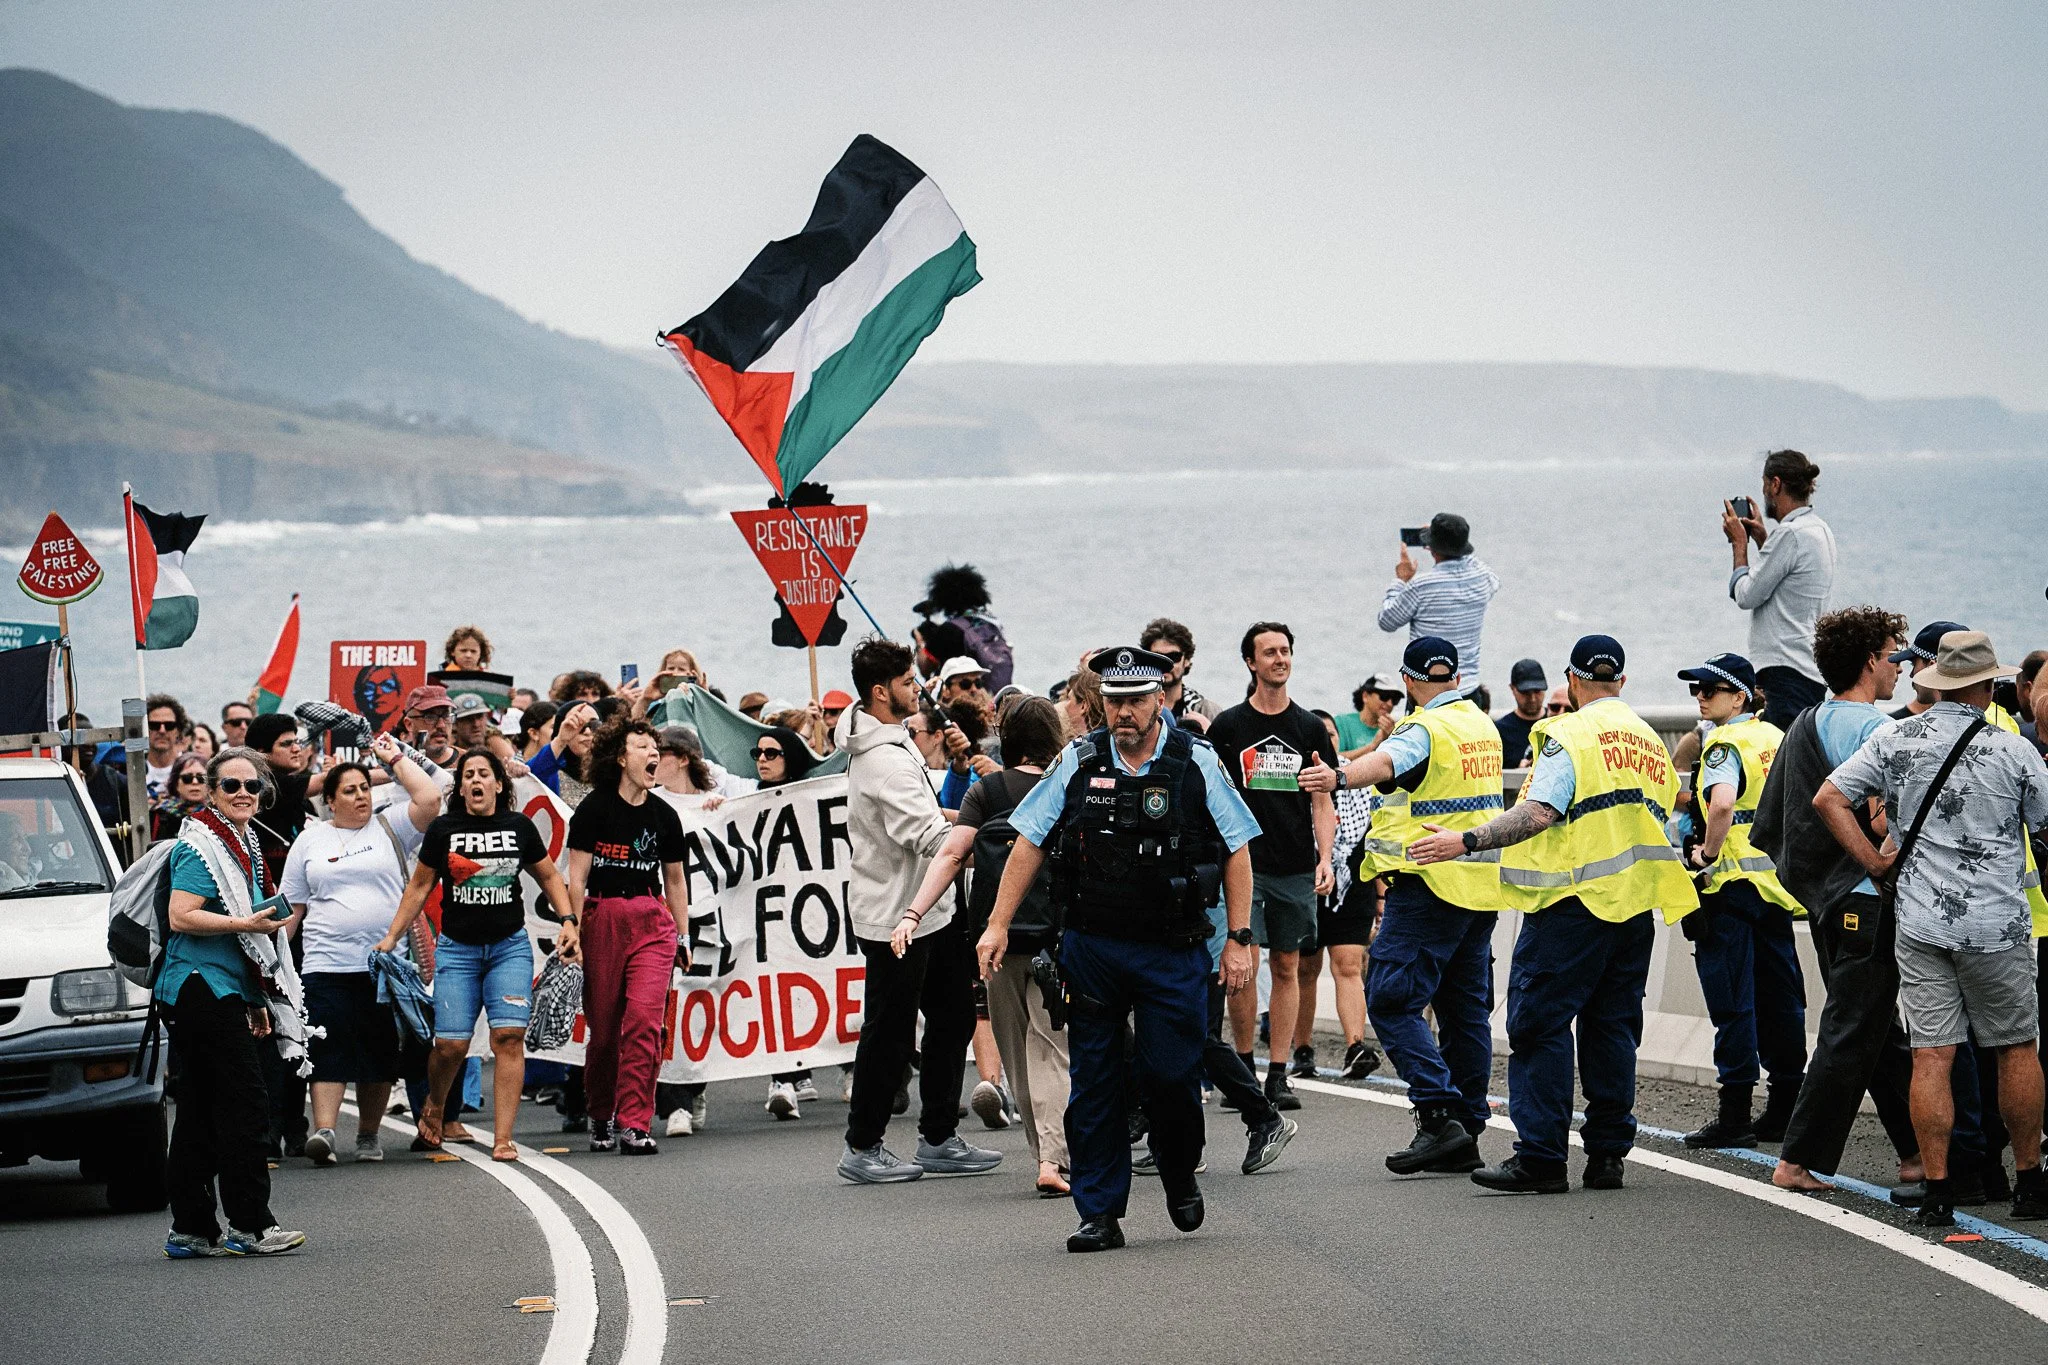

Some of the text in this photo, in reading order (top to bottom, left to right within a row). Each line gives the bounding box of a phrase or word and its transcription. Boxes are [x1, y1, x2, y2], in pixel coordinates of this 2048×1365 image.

[755, 516, 861, 551] RESISTANCE
[42, 538, 75, 555] FREE
[43, 554, 78, 570] FREE
[802, 550, 821, 578] IS
[23, 560, 97, 589] PALESTINE
[781, 578, 837, 606] JUSTIFIED
[340, 645, 417, 667] THE REAL
[1458, 742, 1476, 755] NEW
[1598, 730, 1664, 758] NEW SOUTH WALES
[1253, 762, 1294, 770] ENTERING
[1273, 754, 1294, 762] NOW
[1461, 755, 1491, 780] POLICE
[1602, 746, 1666, 785] POLICE FORCE
[1086, 795, 1116, 805] POLICE
[449, 830, 520, 853] FREE
[595, 841, 630, 860] FREE
[593, 856, 656, 871] PASTIN
[452, 884, 513, 905] PALESTINE
